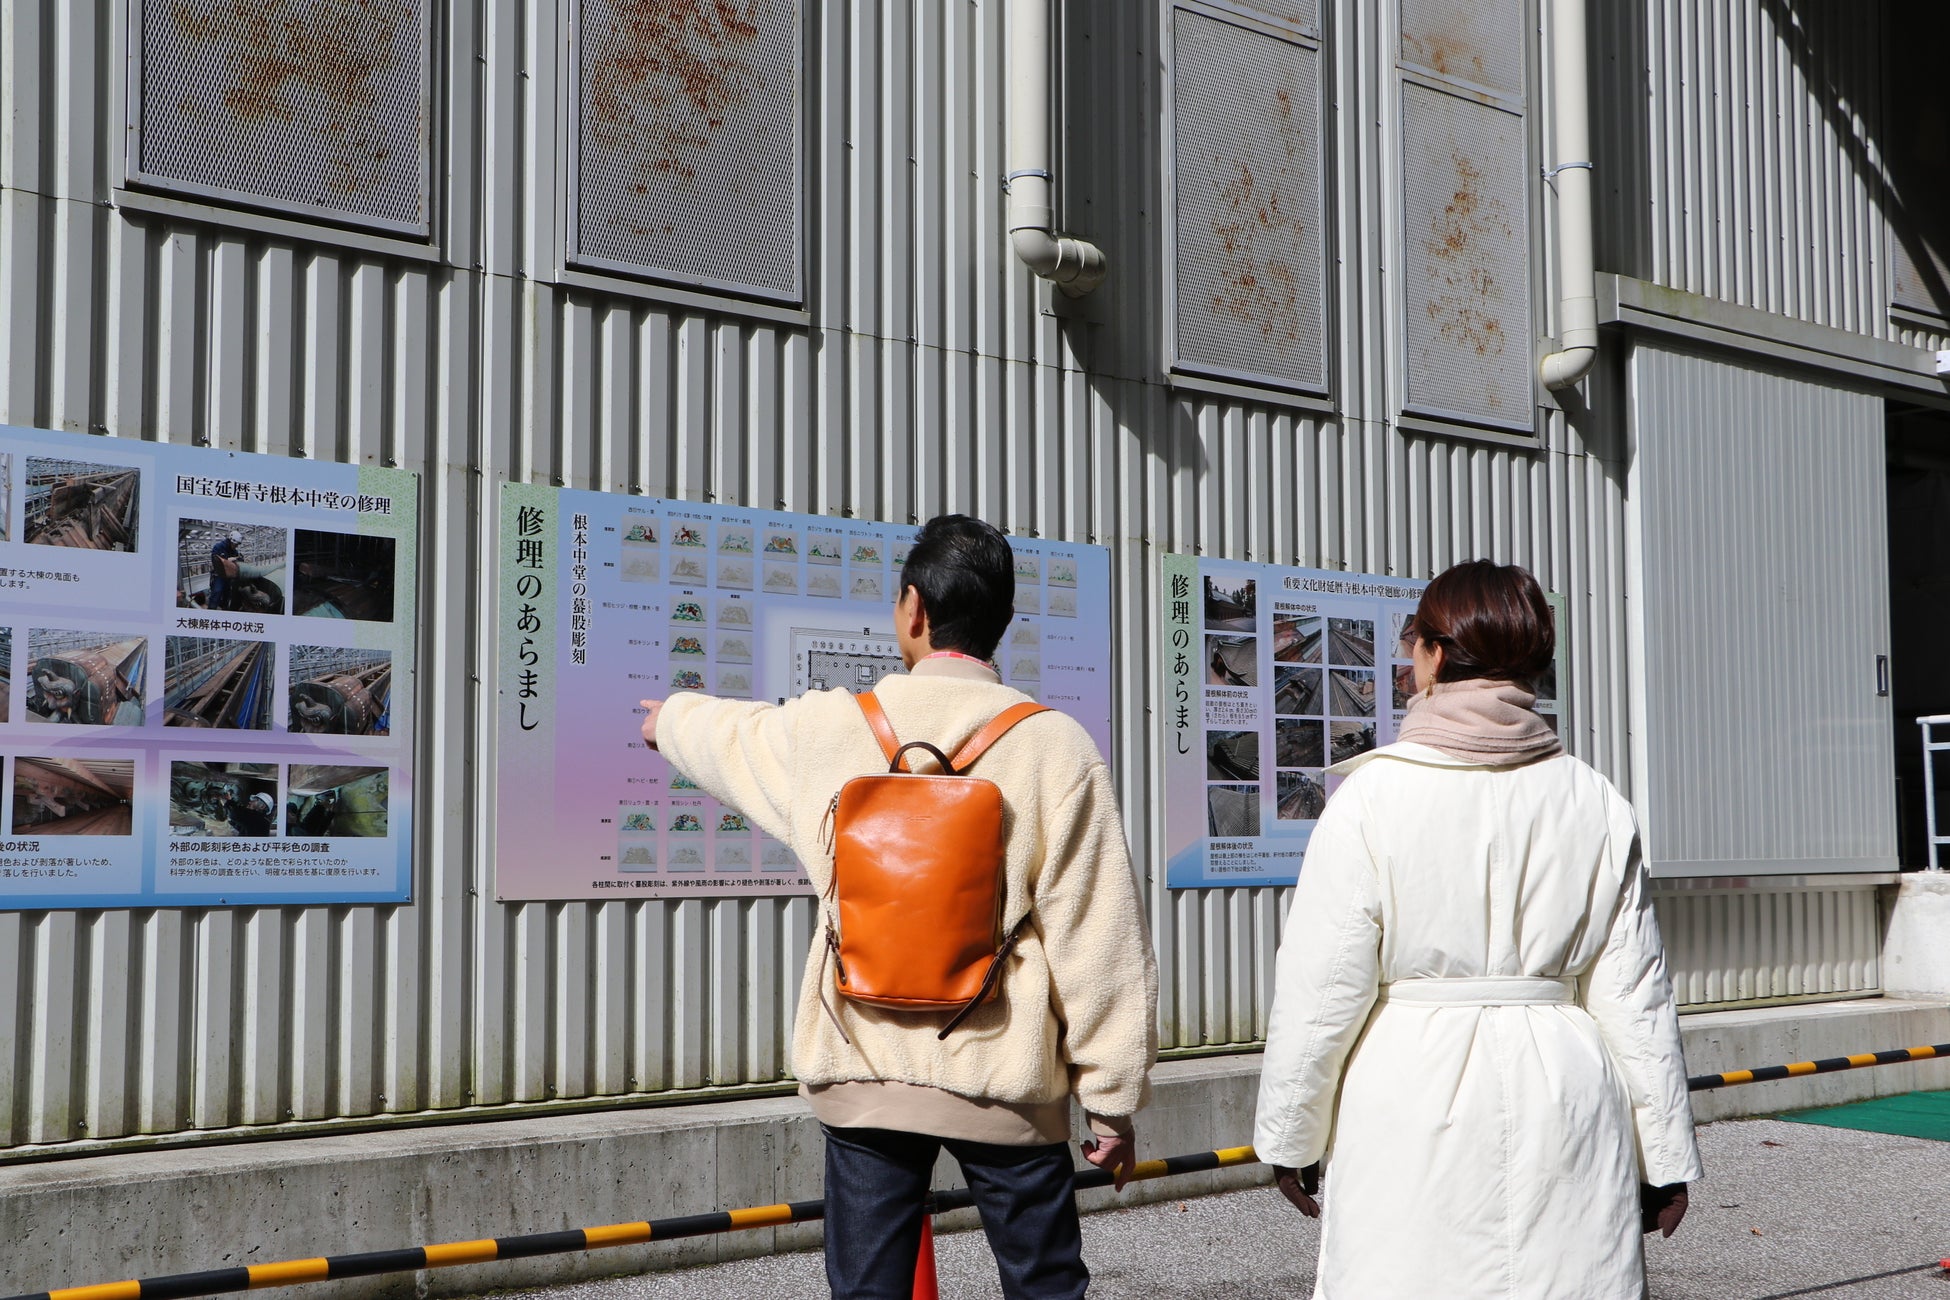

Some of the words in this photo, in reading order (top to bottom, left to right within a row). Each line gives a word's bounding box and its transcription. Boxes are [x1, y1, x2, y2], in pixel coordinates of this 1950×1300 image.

[176, 475, 391, 515] 国宝延暦寺根本中堂の修理
[571, 513, 587, 665] 根本中堂の蟇股彫刻
[1274, 601, 1317, 613] 屋根解体中の状況
[516, 505, 545, 731] 修理のあらまし
[176, 617, 265, 634] 大棟解体中の状況
[863, 627, 870, 636] 西
[1170, 573, 1190, 755] 修理のあらまし
[169, 842, 330, 853] 外部の彫刻彩色および平彩色の調査
[170, 857, 349, 866] 外部の彩色は、どのような配色で彩られていたのか
[0, 868, 79, 878] 落しを行いました。
